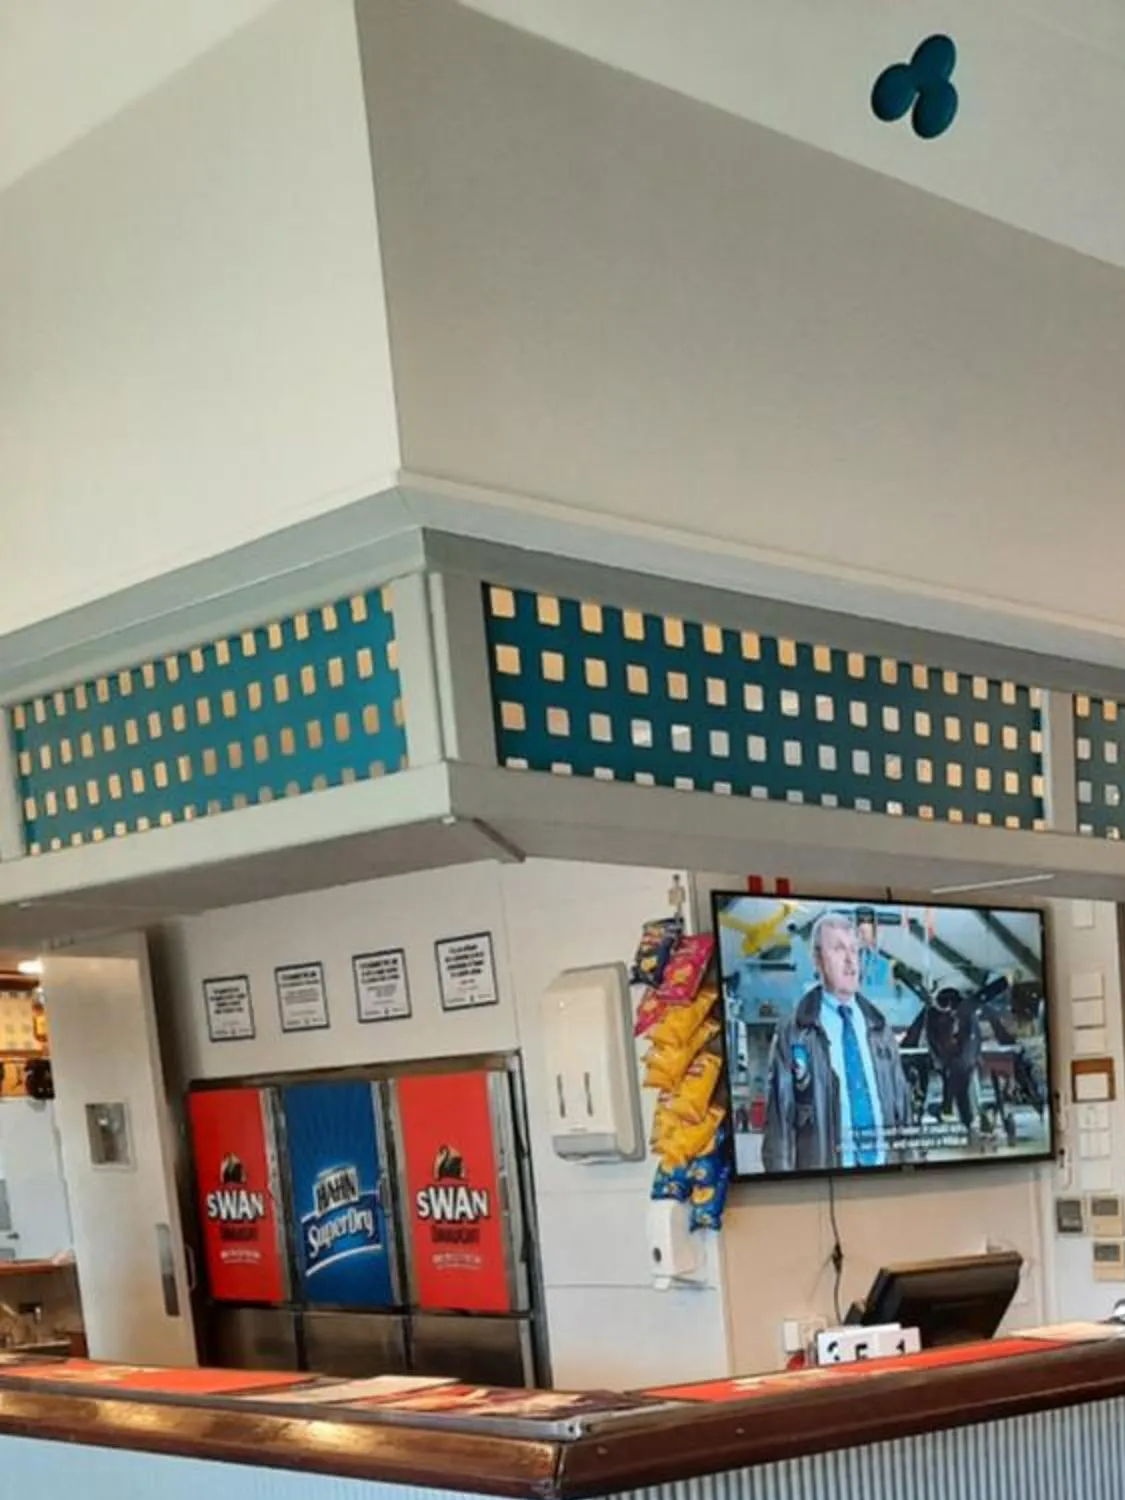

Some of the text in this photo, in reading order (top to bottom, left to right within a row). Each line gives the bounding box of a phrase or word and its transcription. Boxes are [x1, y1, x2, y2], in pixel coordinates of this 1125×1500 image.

[206, 1189, 265, 1221] SWAN
[315, 1169, 358, 1214] HAHN
[415, 1186, 489, 1221] SWAN
